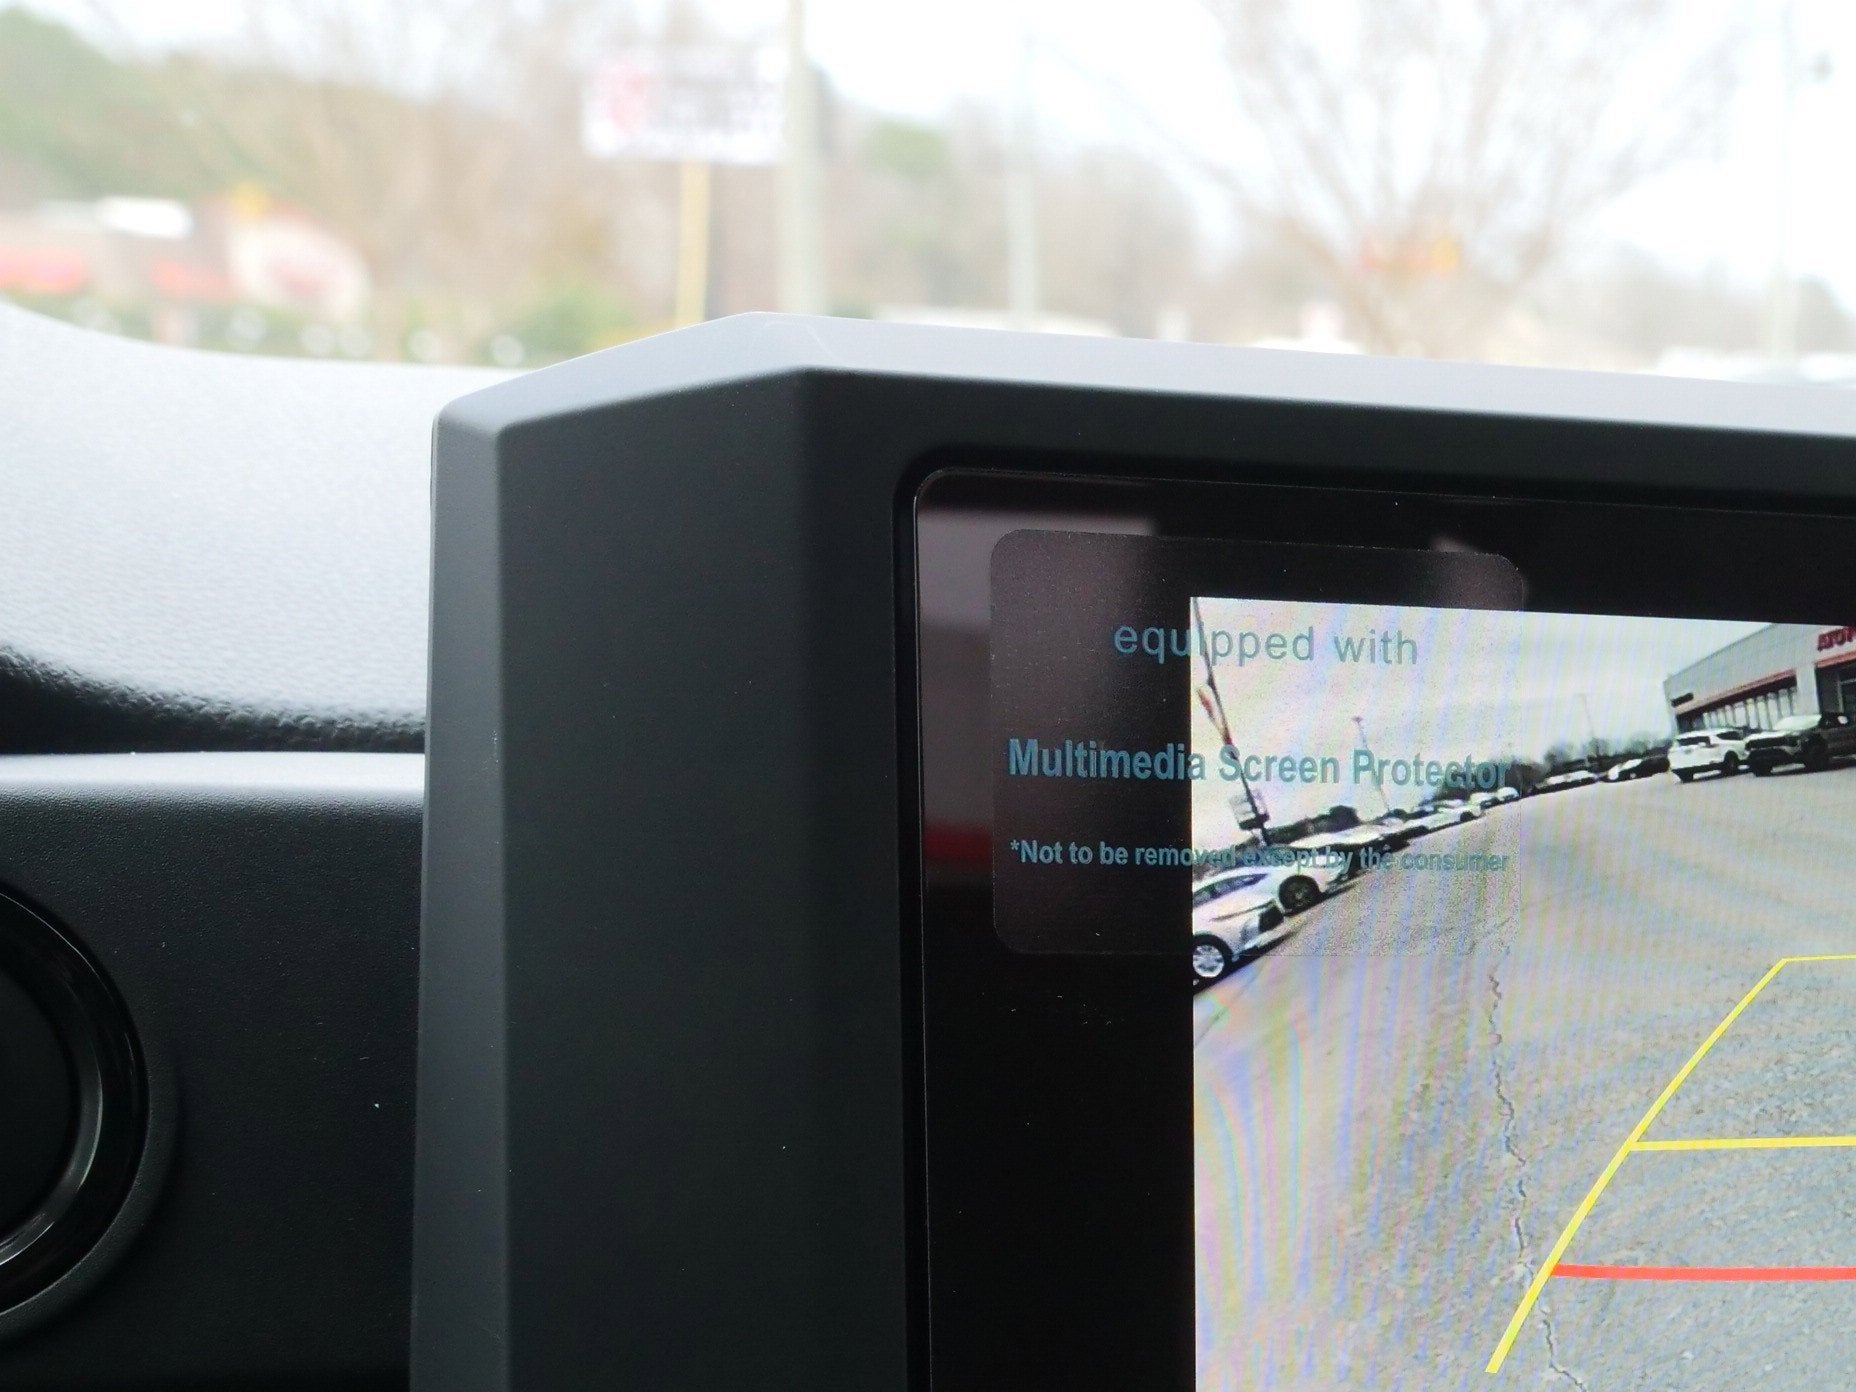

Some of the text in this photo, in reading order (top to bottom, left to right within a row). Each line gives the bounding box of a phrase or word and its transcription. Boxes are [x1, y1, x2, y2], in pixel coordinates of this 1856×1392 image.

[1114, 620, 1418, 666] equipped with
[1008, 737, 1510, 791] Multimedia Screen Protector
[1068, 841, 1093, 866] to
[1101, 841, 1128, 866] be
[1134, 842, 1237, 868] removed
[1243, 847, 1319, 873] except
[1324, 845, 1353, 875] by
[1359, 848, 1396, 869] the
[1402, 852, 1509, 872] consumer
